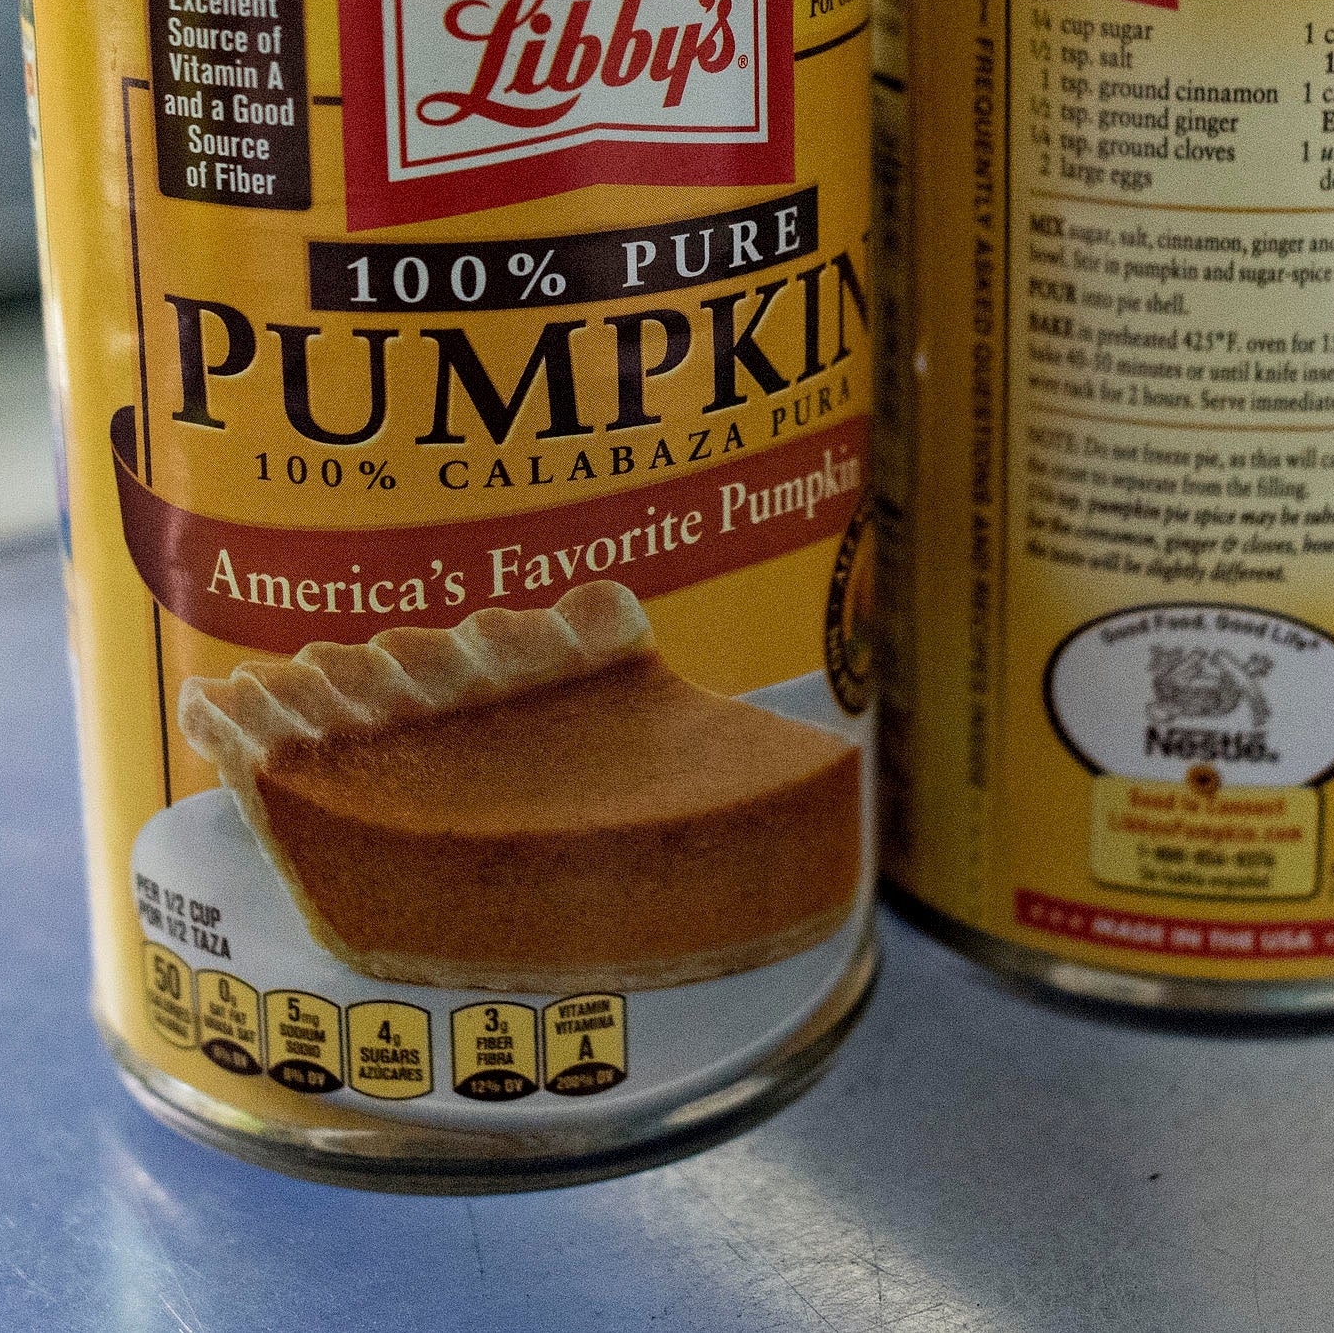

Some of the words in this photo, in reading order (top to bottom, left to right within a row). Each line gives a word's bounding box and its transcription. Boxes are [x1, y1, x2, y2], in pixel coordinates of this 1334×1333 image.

[168, 17, 249, 52] Source
[257, 26, 283, 54] of
[1060, 17, 1095, 43] cup
[1099, 20, 1154, 46] sugar
[1303, 21, 1315, 45] 1
[1099, 44, 1133, 69] salt
[169, 52, 259, 89] Vitamin
[268, 61, 284, 90] A
[1098, 77, 1170, 102] ground
[1175, 78, 1280, 104] cinnamon
[1302, 81, 1313, 105] 1
[164, 91, 203, 119] and
[211, 98, 225, 121] a
[232, 94, 295, 127] Good
[1098, 106, 1170, 131] ground
[1174, 109, 1240, 138] ginger
[188, 124, 271, 159] Source
[1097, 135, 1169, 162] ground
[1173, 139, 1237, 163] cloves
[1300, 140, 1312, 164] 1
[186, 160, 208, 188] of
[214, 162, 277, 195] Fiber
[1060, 156, 1106, 188] large
[1109, 168, 1153, 191] eggs
[347, 247, 567, 304] 100%
[623, 206, 803, 287] PURE
[1156, 228, 1249, 257] cinnamon,
[1250, 230, 1306, 259] ginger
[1123, 256, 1199, 285] pumpkin
[1203, 257, 1235, 282] and
[1237, 264, 1333, 290] sugar-spice
[1116, 293, 1142, 317] pie
[1145, 291, 1191, 317] shell.
[1096, 325, 1179, 356] preheated
[1245, 336, 1287, 355] oven
[1289, 331, 1317, 355] for
[1209, 359, 1252, 382] until
[1254, 359, 1299, 384] knife
[1199, 388, 1247, 413] Serve
[256, 450, 397, 492] 100%
[439, 420, 747, 491] CALABAZA
[772, 374, 852, 438] PURA
[208, 547, 468, 616] America's
[488, 505, 704, 602] Favorite
[189, 899, 222, 929] CUP
[191, 925, 232, 961] TAZA
[153, 953, 181, 1001] 50
[484, 1007, 509, 1034] 3g
[557, 999, 611, 1019] VITAMIN
[377, 1019, 402, 1047] 4g
[554, 1014, 616, 1036] VITAMINA
[359, 1046, 421, 1065] SUGARS
[475, 1035, 514, 1051] FIBER
[578, 1034, 596, 1061] A
[476, 1052, 515, 1067] FIBRA
